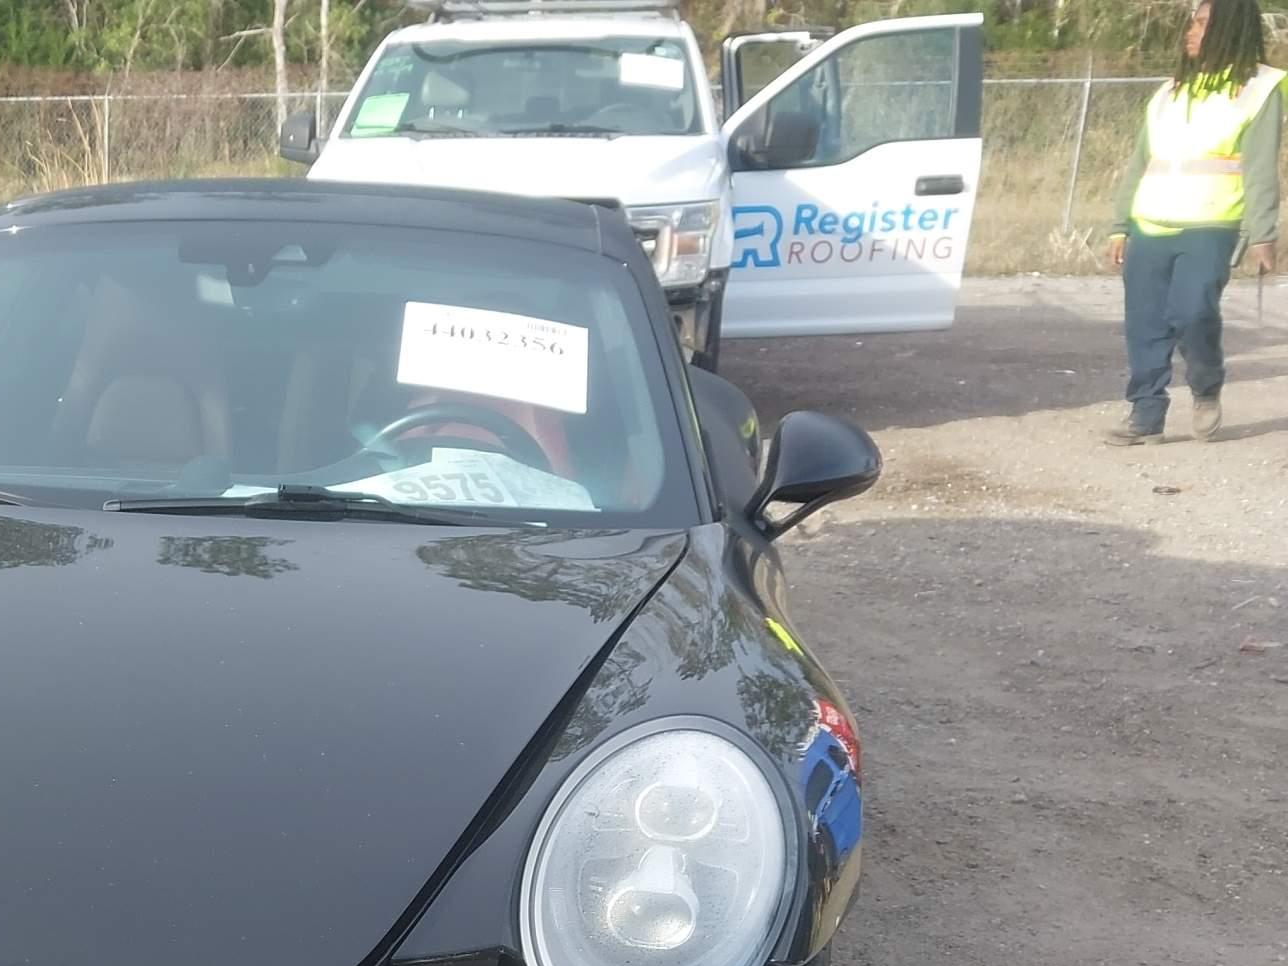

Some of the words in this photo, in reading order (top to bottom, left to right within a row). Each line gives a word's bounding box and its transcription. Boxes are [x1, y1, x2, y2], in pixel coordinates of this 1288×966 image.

[792, 201, 960, 244] Register
[787, 236, 954, 265] ROOFING
[393, 472, 505, 503] 9575
